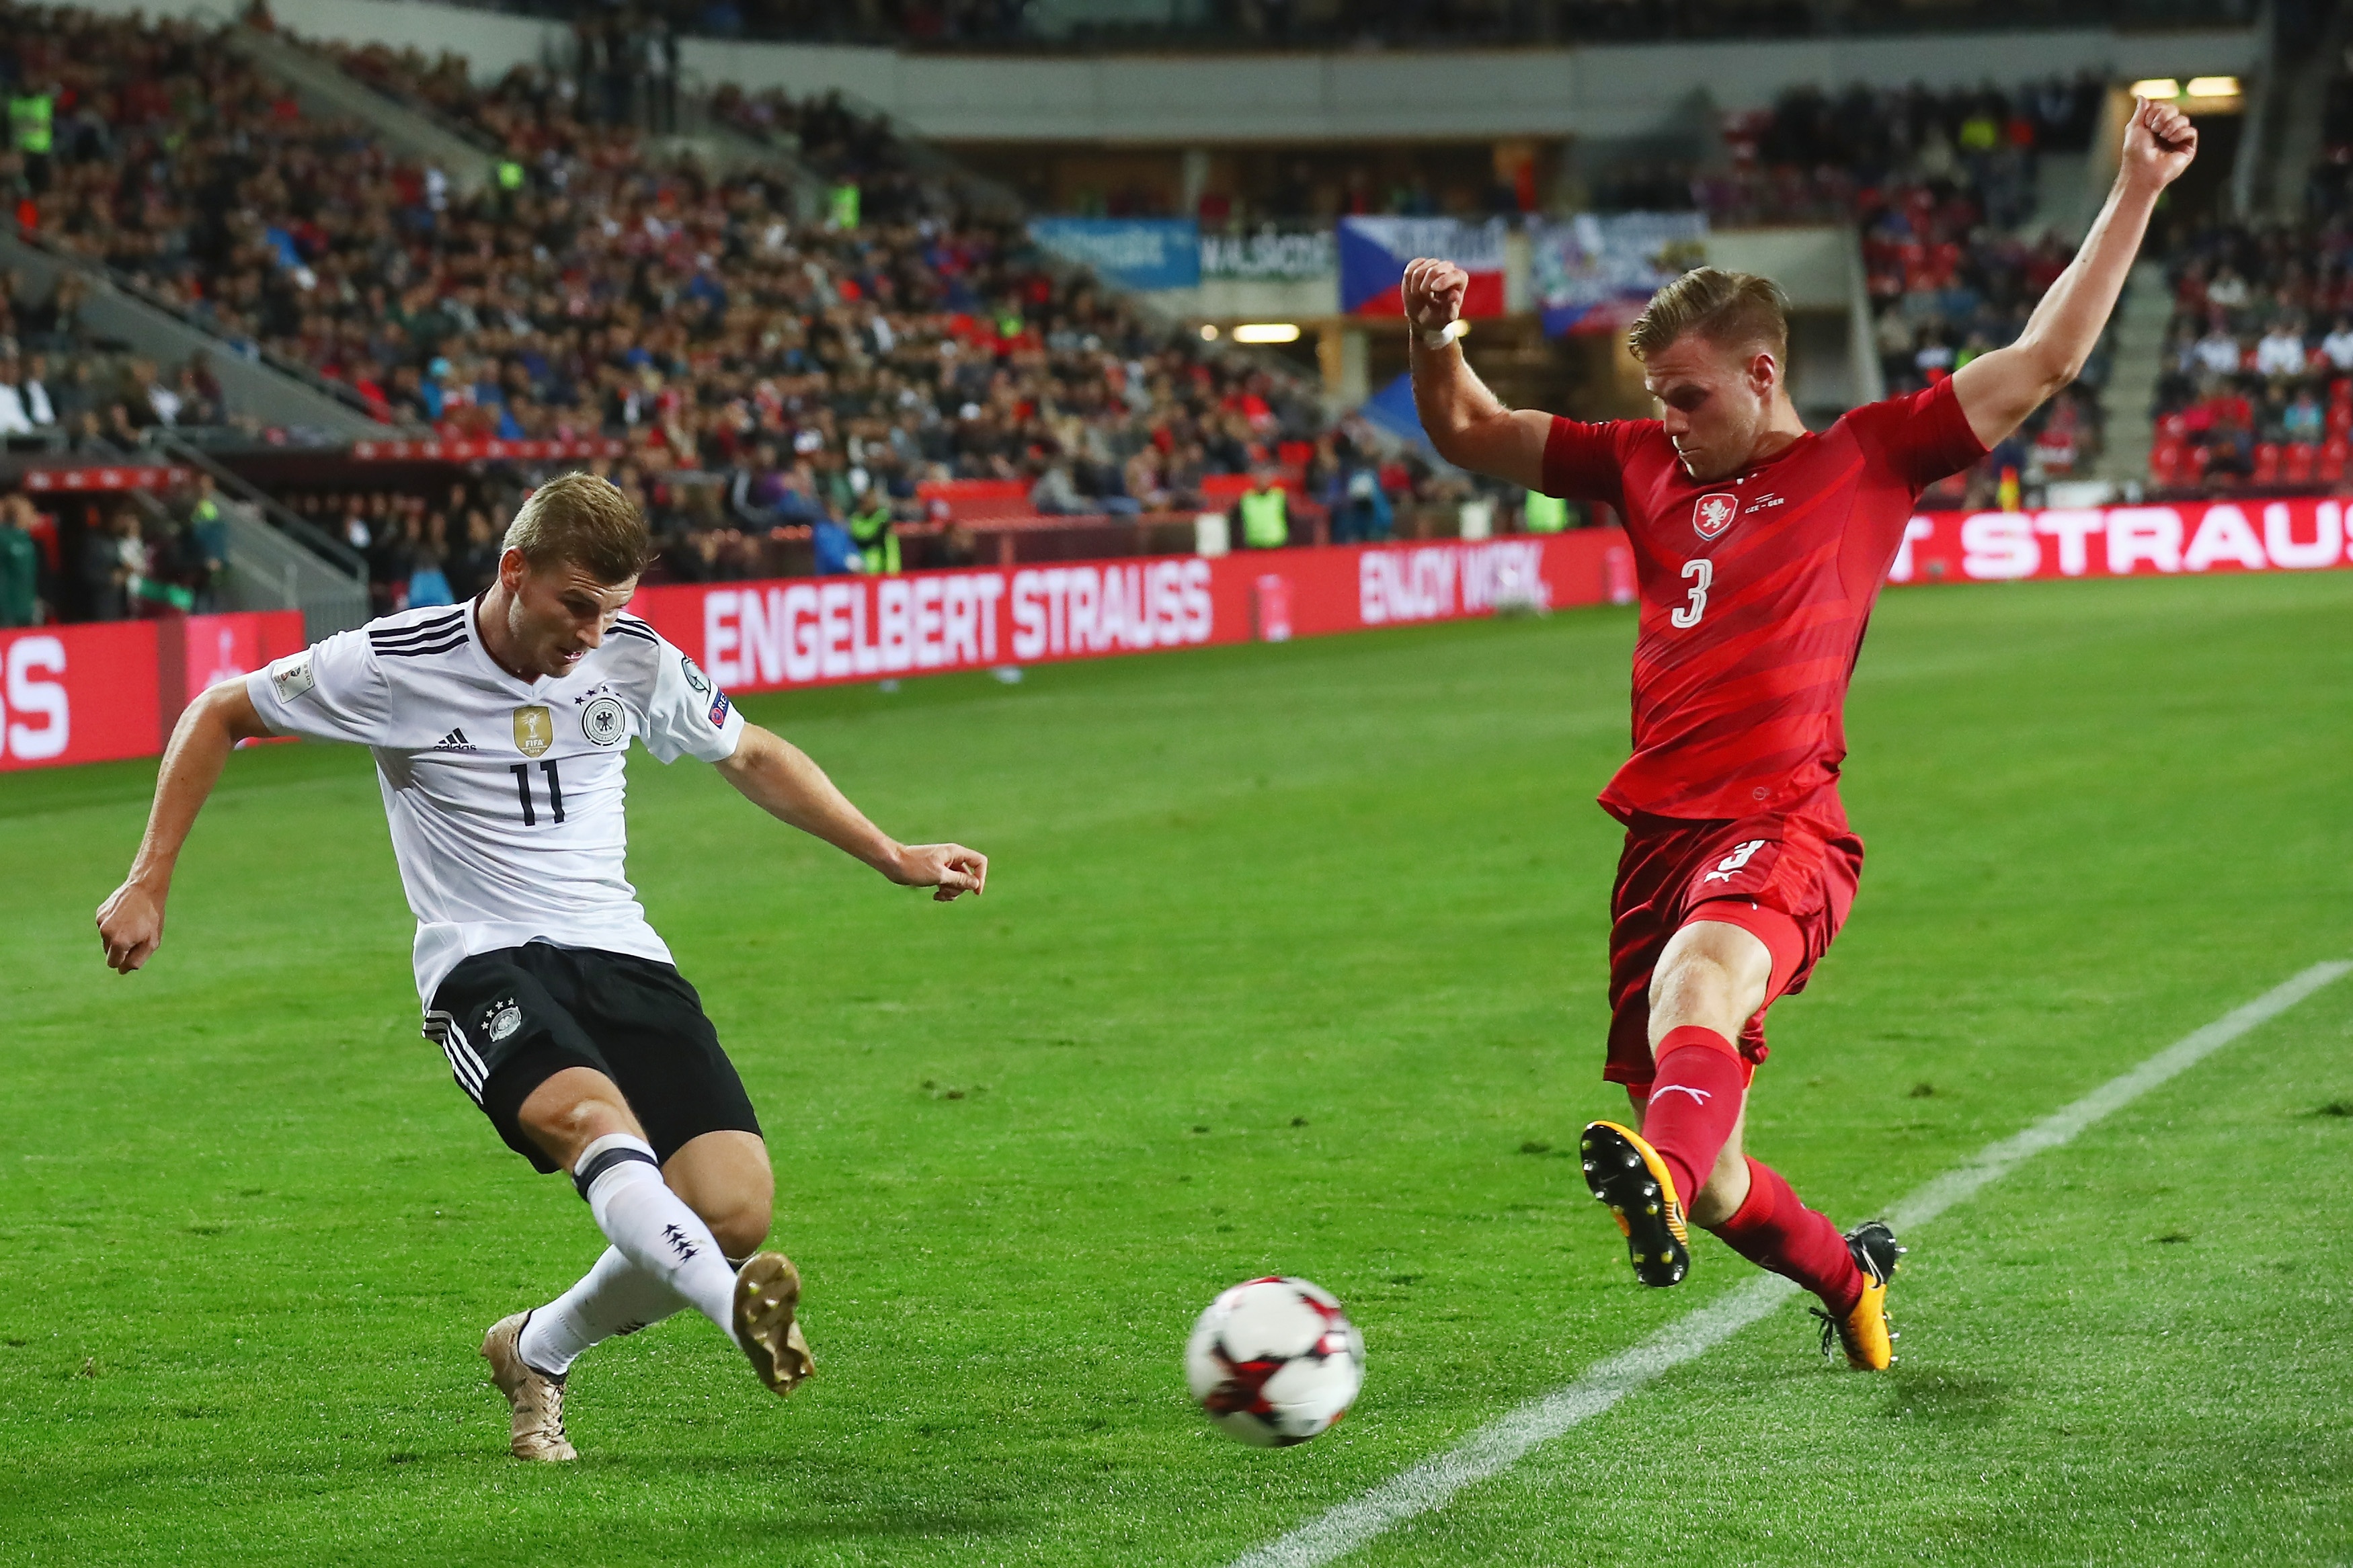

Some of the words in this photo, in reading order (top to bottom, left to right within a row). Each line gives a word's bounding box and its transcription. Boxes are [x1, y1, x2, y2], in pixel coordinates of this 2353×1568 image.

[1960, 500, 2353, 579] STRAU
[703, 573, 1004, 688] ENGELBERT
[1012, 559, 1213, 659] STRAUSS
[1671, 559, 1713, 628] 3
[525, 739, 543, 747] FIFA
[510, 760, 565, 826] 11
